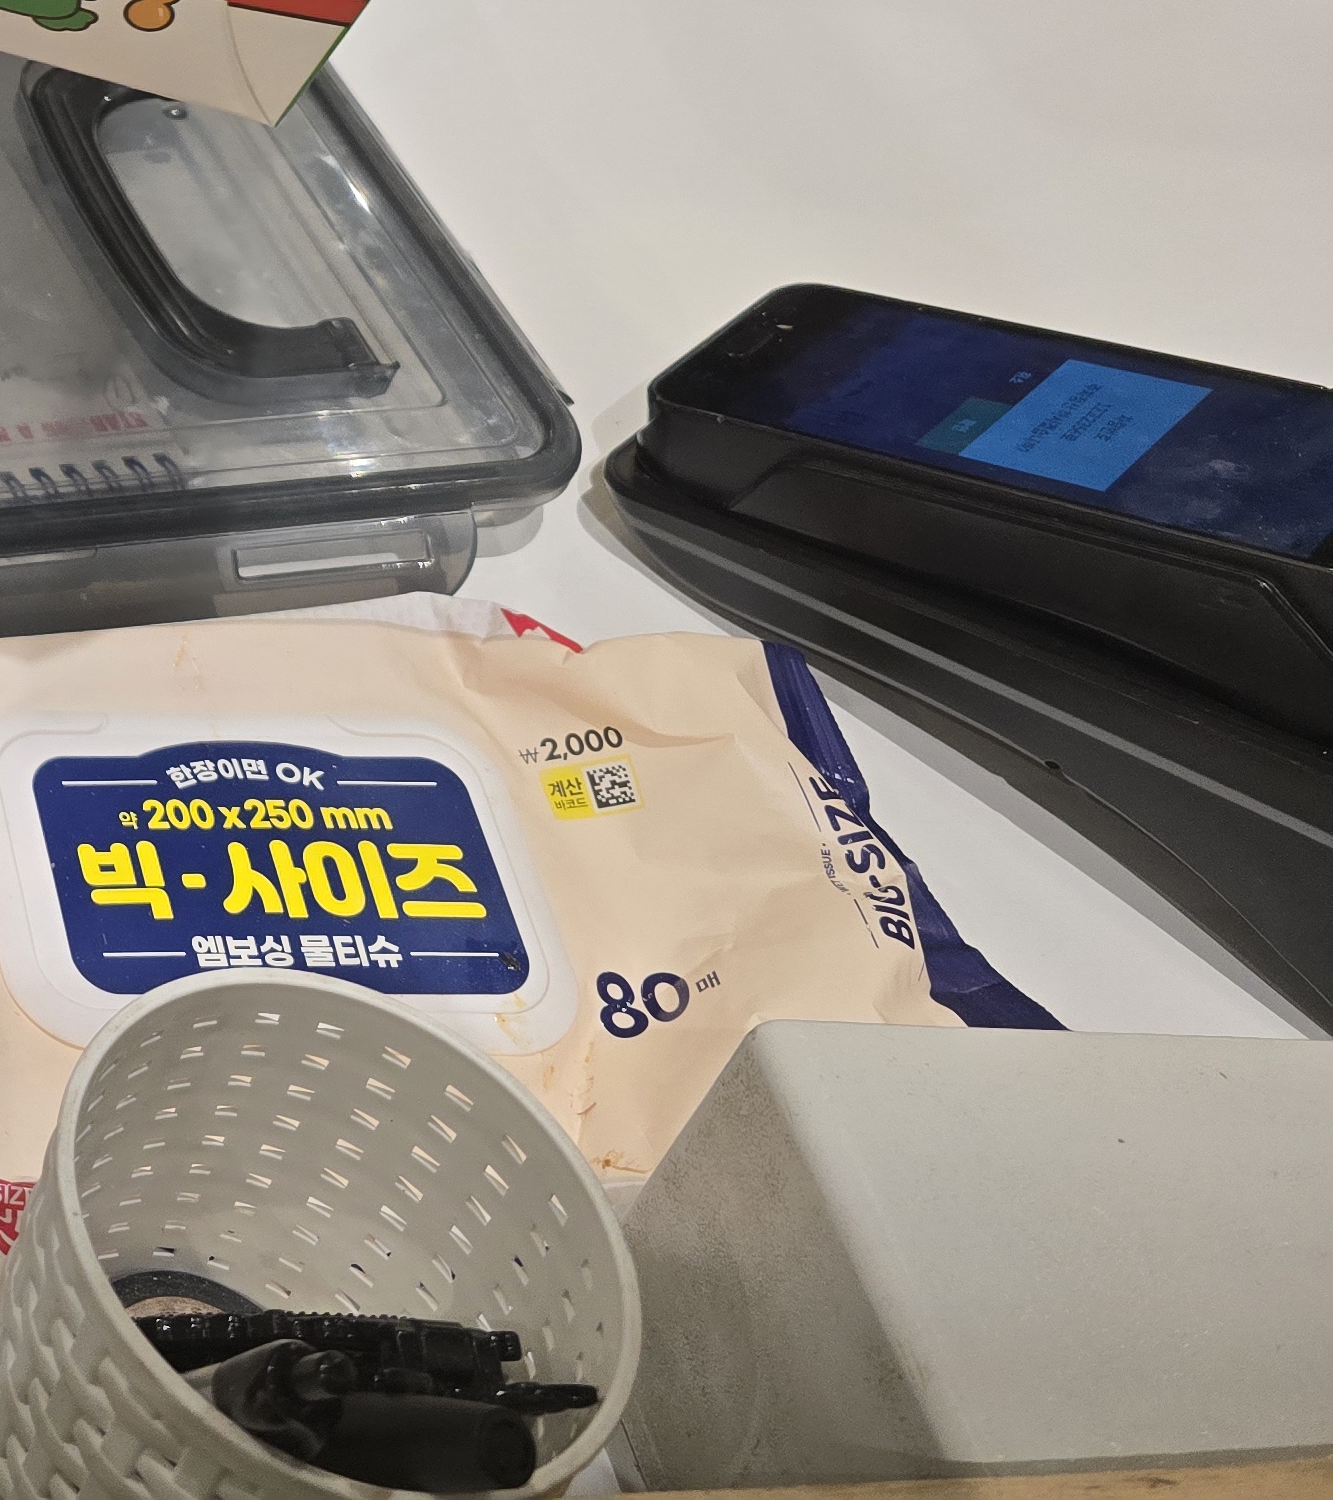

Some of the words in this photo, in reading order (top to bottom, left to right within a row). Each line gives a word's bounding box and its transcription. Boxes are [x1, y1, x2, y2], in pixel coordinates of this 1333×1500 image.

[166, 758, 268, 789] 한장이면
[275, 762, 325, 790] OK
[547, 777, 584, 798] 계산
[119, 810, 139, 830] 약
[320, 805, 394, 830] mm
[554, 797, 589, 810] 바코드
[191, 935, 295, 968] 엠보싱
[300, 934, 403, 968] 물티슈
[596, 971, 690, 1038] 80
[695, 971, 721, 993] 매
